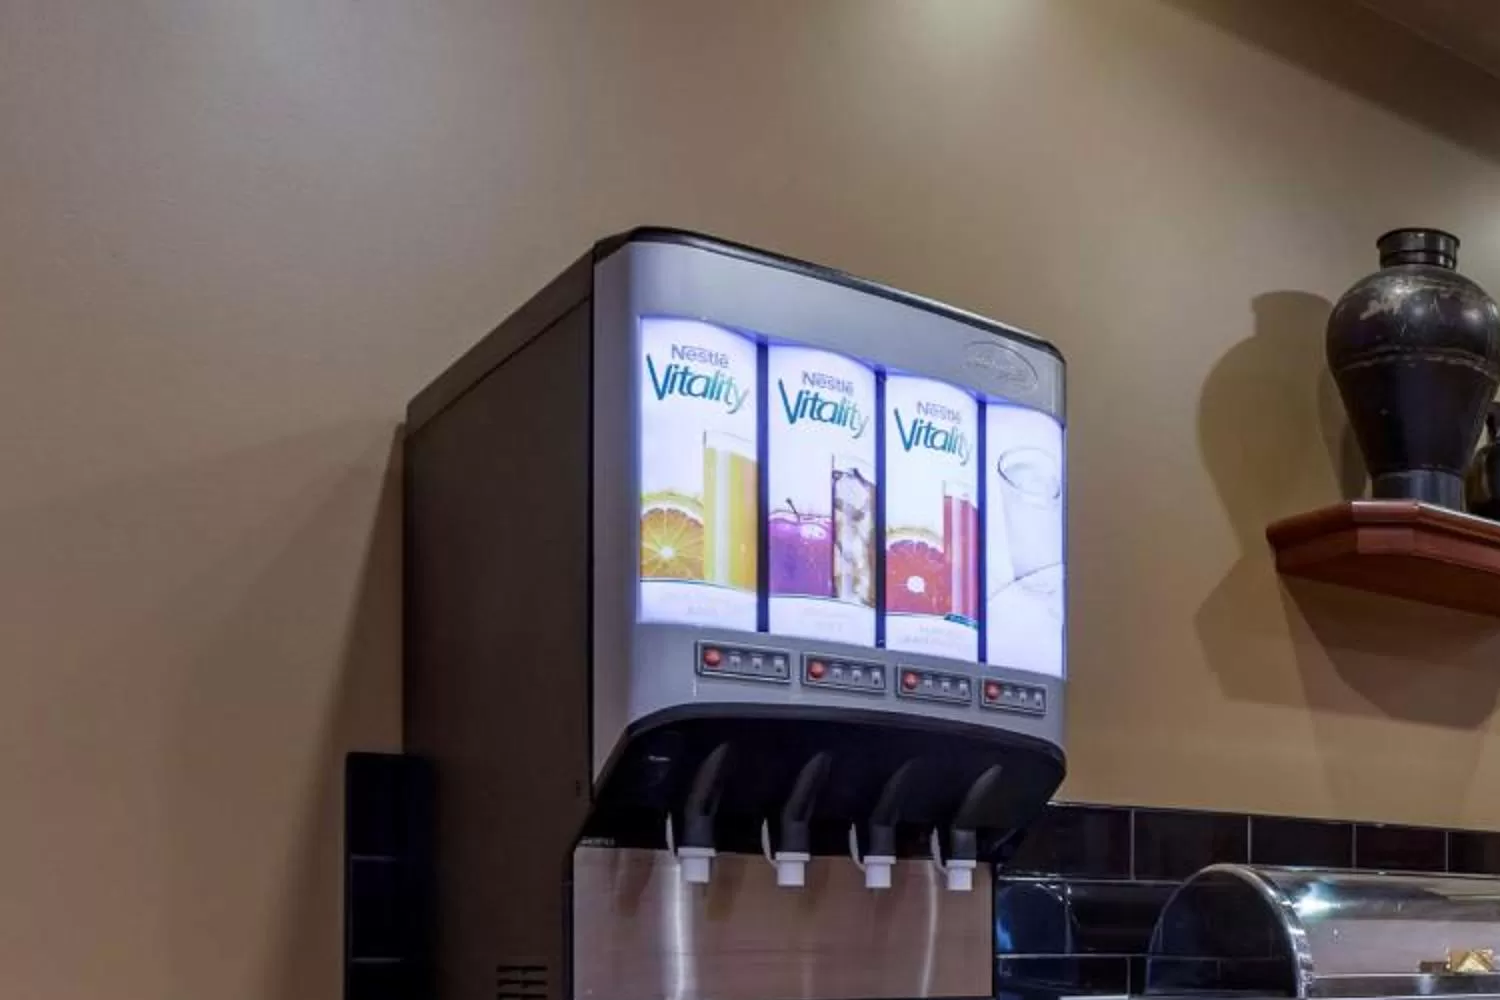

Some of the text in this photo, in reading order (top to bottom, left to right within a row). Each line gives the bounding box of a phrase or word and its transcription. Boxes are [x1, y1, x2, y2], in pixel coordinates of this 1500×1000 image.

[646, 352, 750, 415] Vitality
[777, 377, 870, 440] Vitality
[893, 407, 973, 467] Vitality
